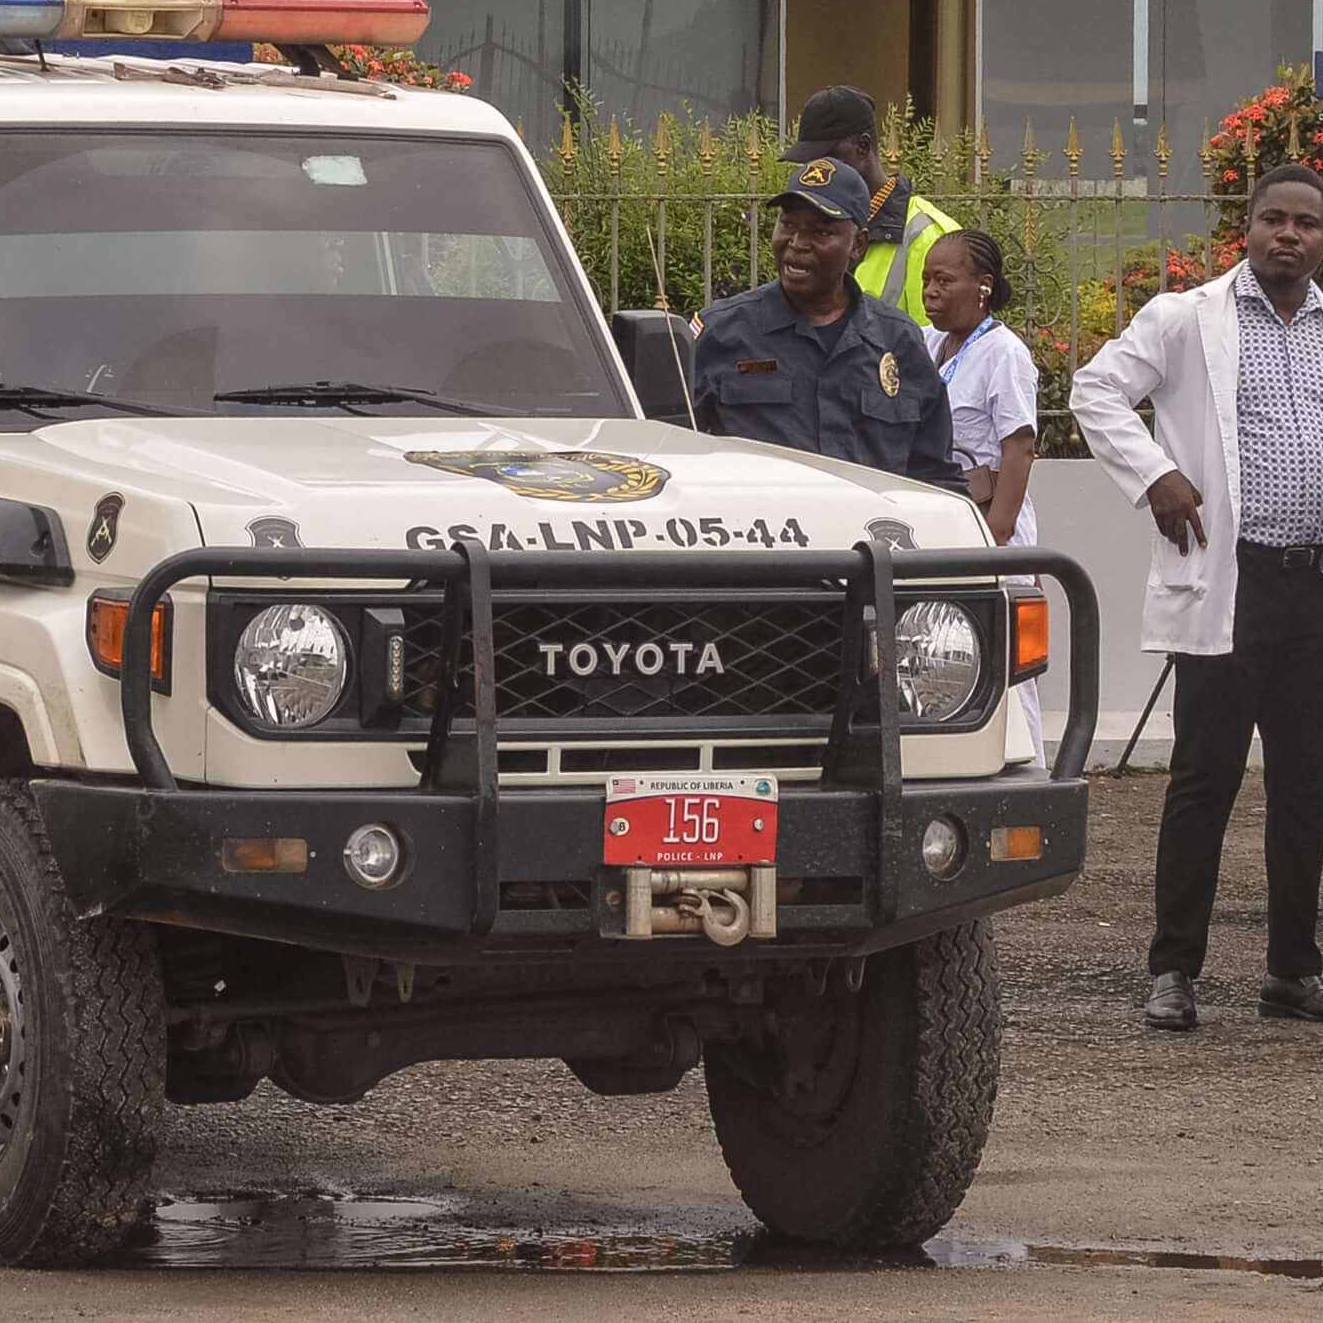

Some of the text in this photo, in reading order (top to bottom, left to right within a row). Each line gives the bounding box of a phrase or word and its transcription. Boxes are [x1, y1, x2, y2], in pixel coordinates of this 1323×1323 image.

[539, 643, 725, 676] TOYOTA
[650, 781, 733, 790] REPUBLIC OF LIBERIA
[663, 798, 720, 843] 156
[657, 852, 693, 862] POLICE
[704, 852, 724, 862] LNP
